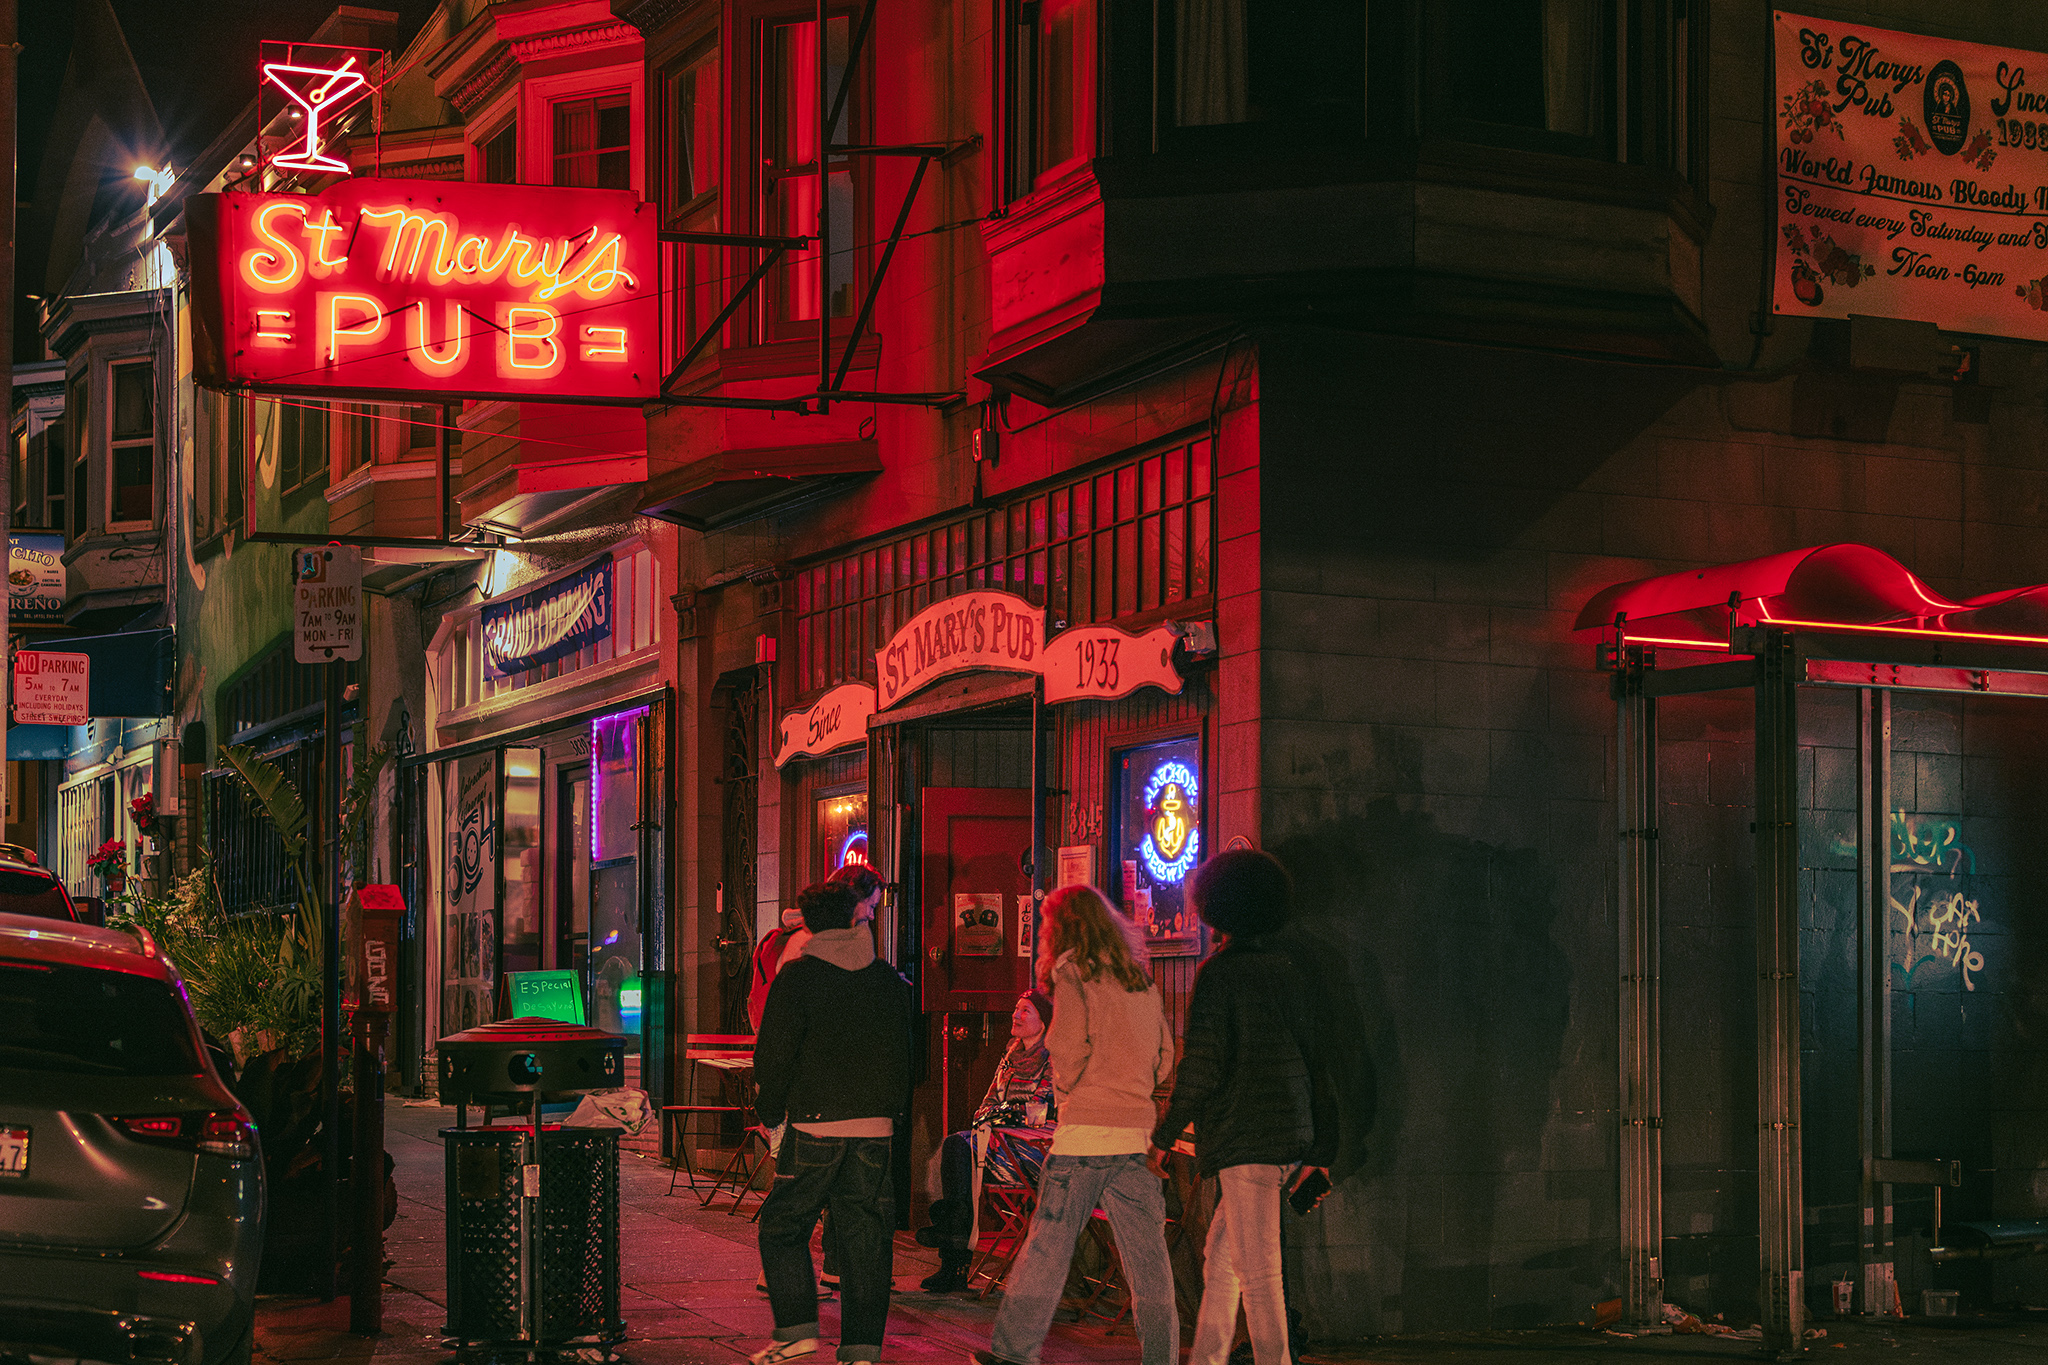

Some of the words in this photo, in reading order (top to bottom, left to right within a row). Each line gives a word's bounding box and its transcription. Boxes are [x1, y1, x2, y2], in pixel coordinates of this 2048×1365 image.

[1799, 28, 1832, 69] St
[1837, 36, 1925, 94] Marys
[1832, 74, 1894, 118] Pub
[1991, 61, 2048, 117] Sinc
[1937, 125, 1956, 134] PUB
[1780, 147, 1853, 186] World
[1860, 164, 1943, 201] Famous
[1950, 178, 2029, 215] Bloody
[1785, 185, 1855, 224] Served
[1856, 214, 1907, 240] every
[1909, 210, 1995, 251] Saturday
[1998, 230, 2032, 247] and
[240, 203, 352, 293] St
[361, 206, 640, 302] Mary's
[1887, 247, 1950, 280] Noon
[316, 291, 566, 379] PUB
[10, 547, 54, 567] CITO
[10, 594, 62, 611] REÑO
[301, 586, 356, 608] PARKING
[538, 572, 606, 650] OPENING
[301, 611, 322, 628] 7AM
[334, 609, 356, 626] 9AM
[303, 630, 326, 642] MON
[338, 629, 354, 641] FRI
[19, 654, 36, 672] NO
[42, 659, 85, 675] PARKING
[885, 641, 911, 698] ST
[913, 598, 985, 676] MARY'S
[990, 603, 1034, 662] PUB
[1075, 638, 1120, 691] 1933
[19, 702, 51, 710] INCLUDING
[54, 703, 84, 711] HOLIDAYS
[21, 713, 46, 721] STREET
[49, 714, 81, 722] SWEEPING
[35, 694, 68, 702] EVERYDAY
[807, 704, 841, 747] Since
[1069, 801, 1103, 840] 3845
